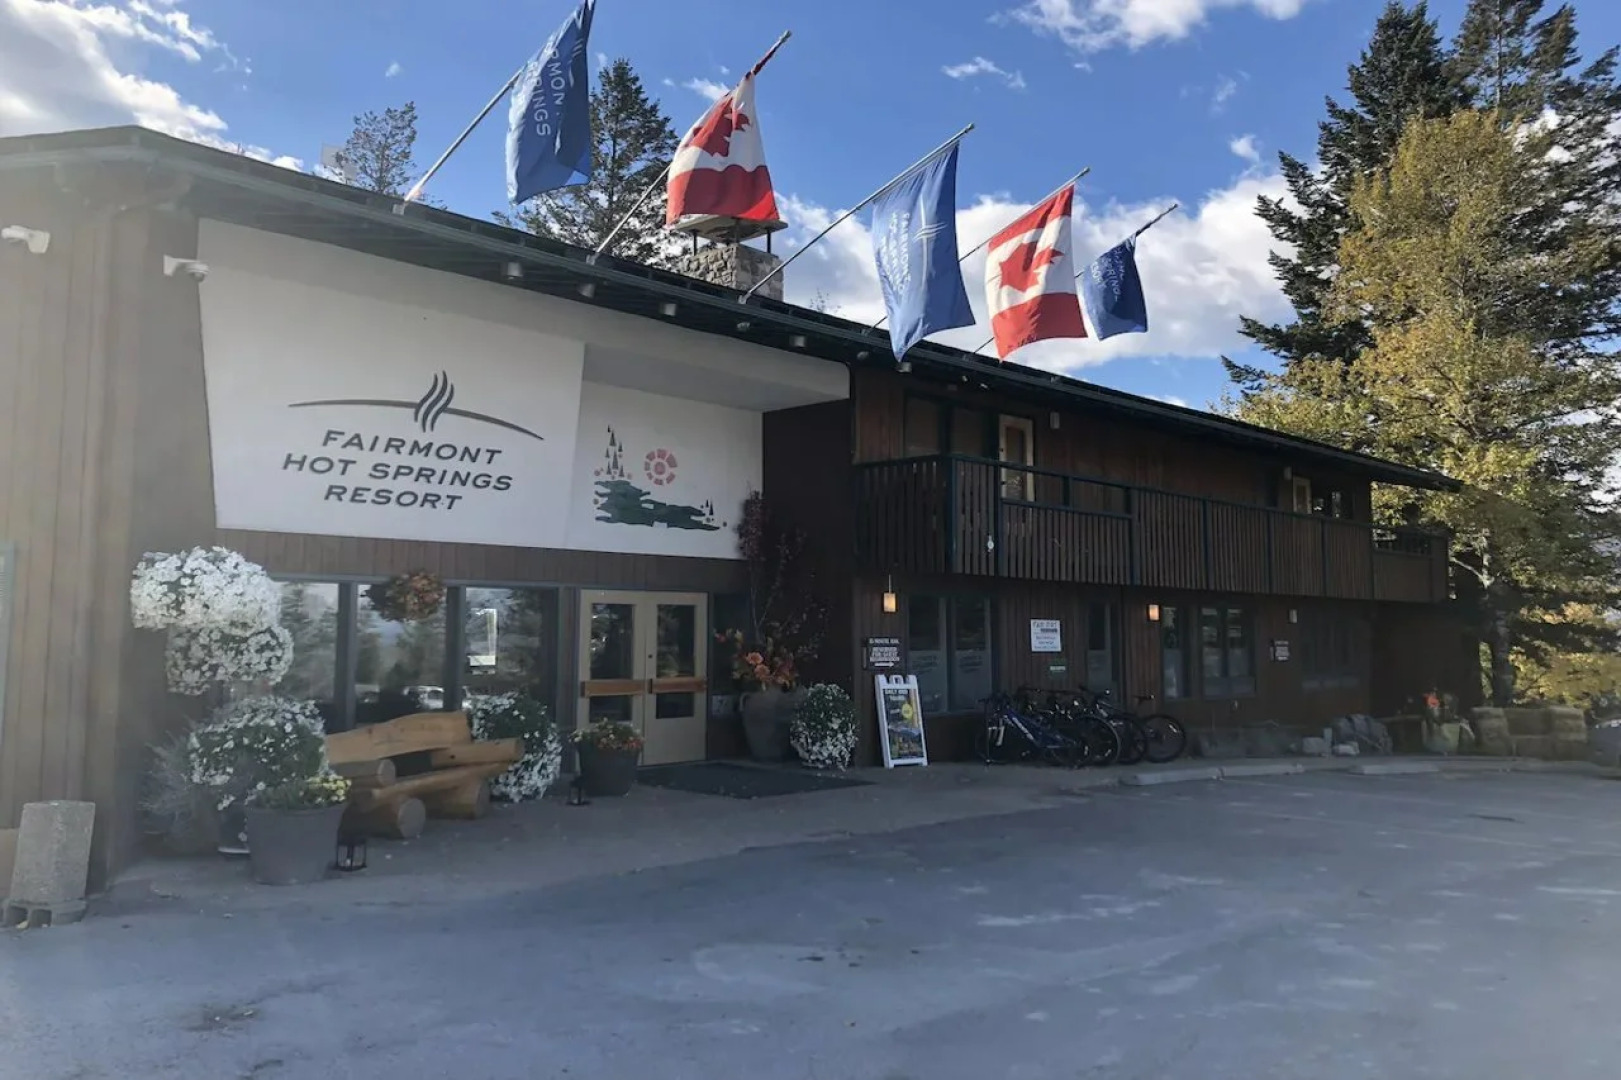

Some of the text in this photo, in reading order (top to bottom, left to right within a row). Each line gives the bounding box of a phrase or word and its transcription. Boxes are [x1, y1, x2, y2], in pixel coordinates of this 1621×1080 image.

[322, 429, 502, 464] FAIRMONT
[282, 453, 513, 491] HOT SPRINGS
[324, 484, 463, 510] RESORT
